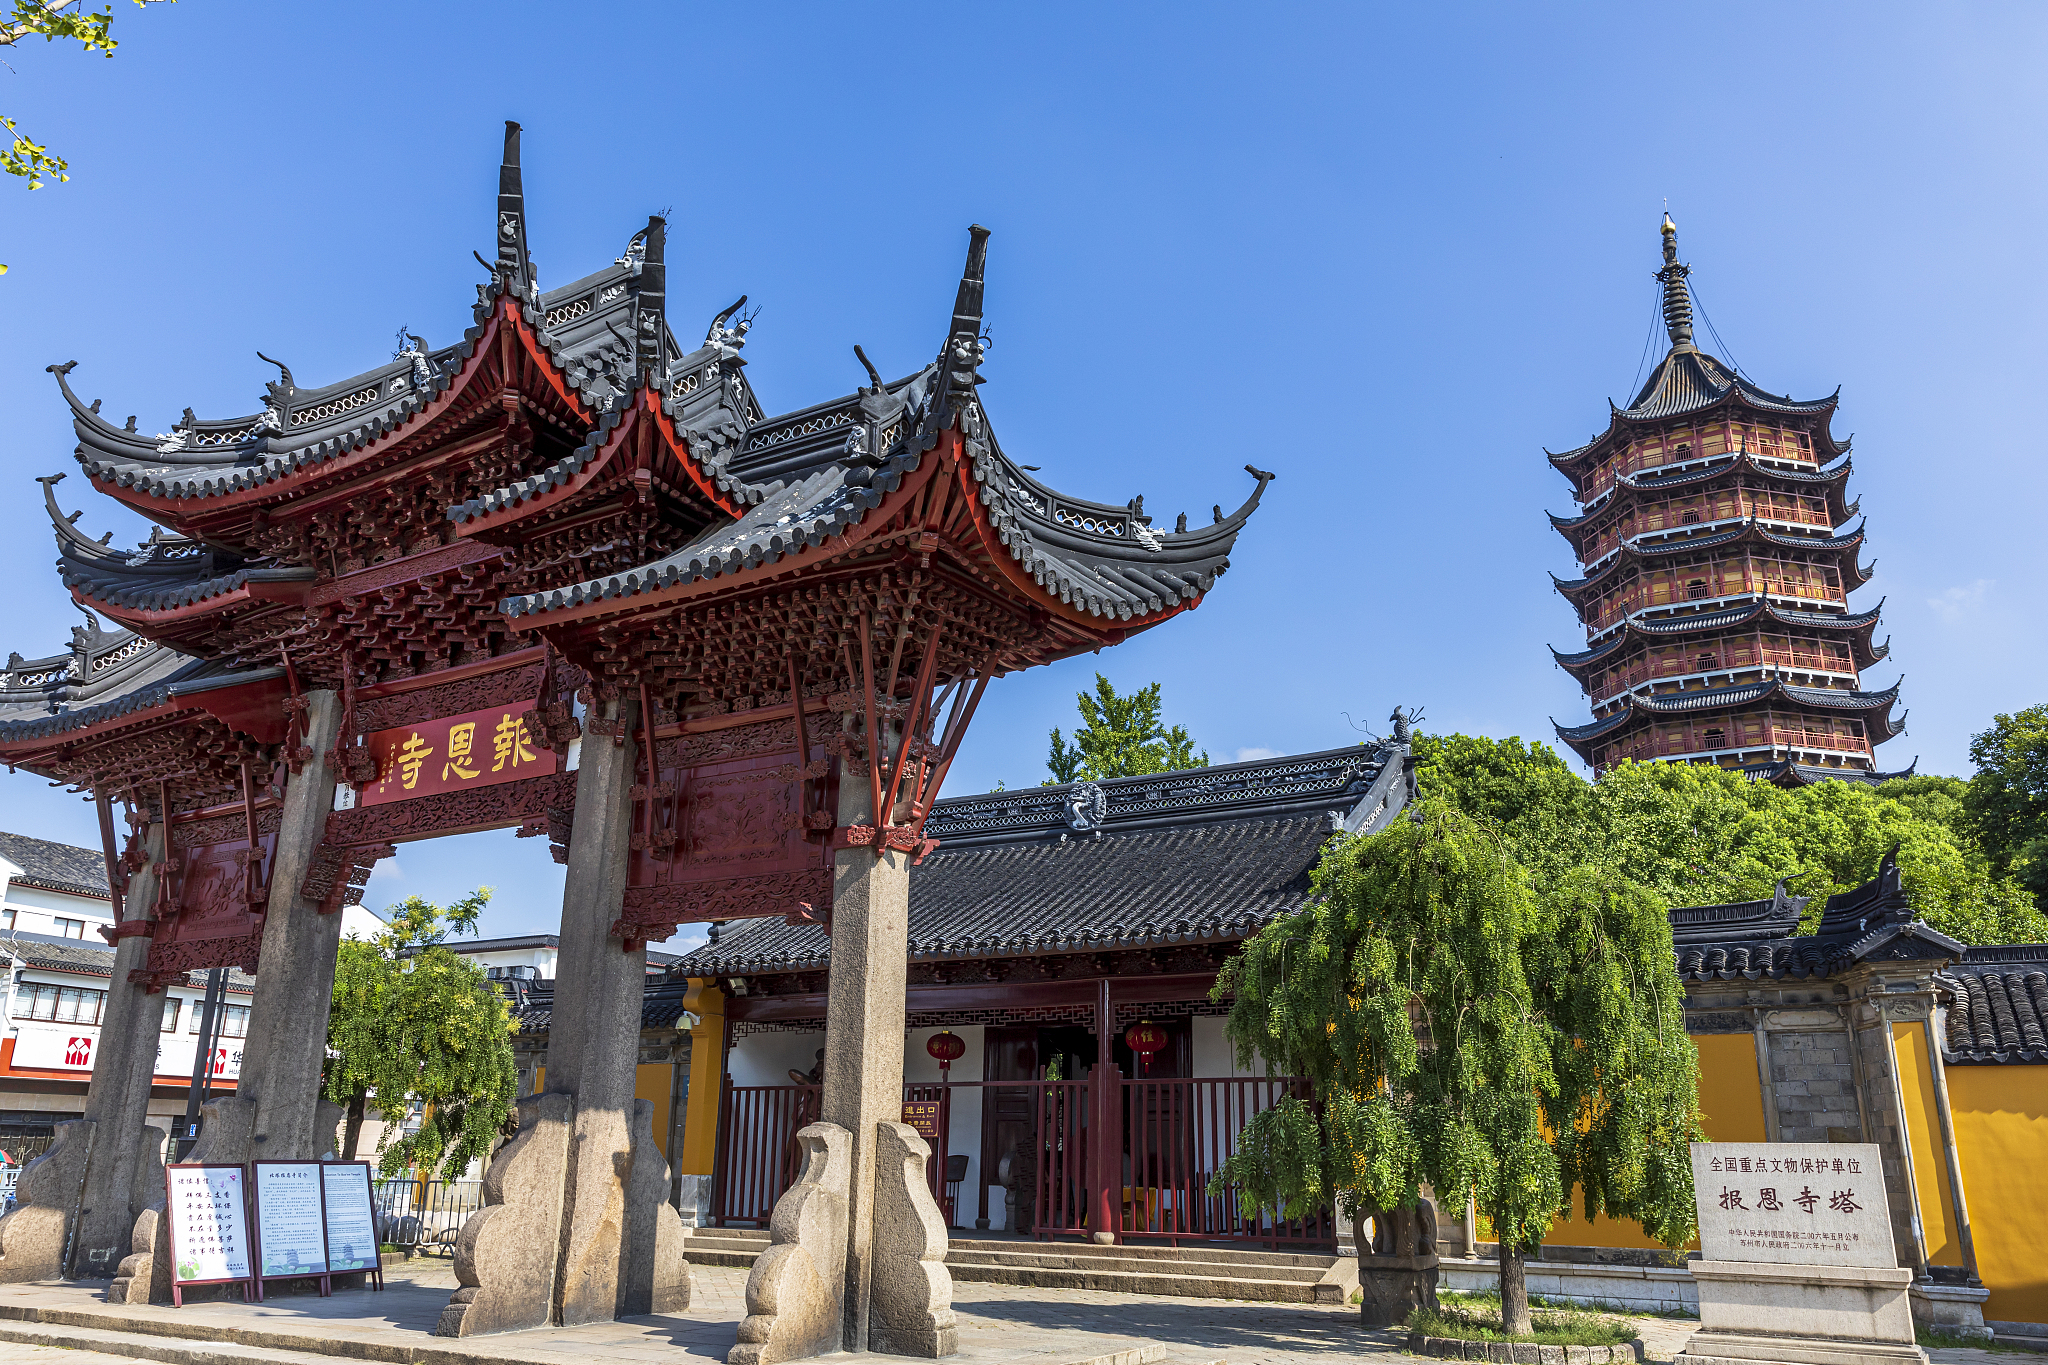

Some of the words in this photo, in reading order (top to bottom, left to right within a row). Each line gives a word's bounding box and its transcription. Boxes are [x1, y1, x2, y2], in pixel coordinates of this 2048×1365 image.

[231, 1050, 243, 1066] 华
[904, 1105, 935, 1115] 進出口
[1709, 1156, 1862, 1175] 全国重点文物保护单位
[1718, 1185, 1864, 1215] 报恩寺塔
